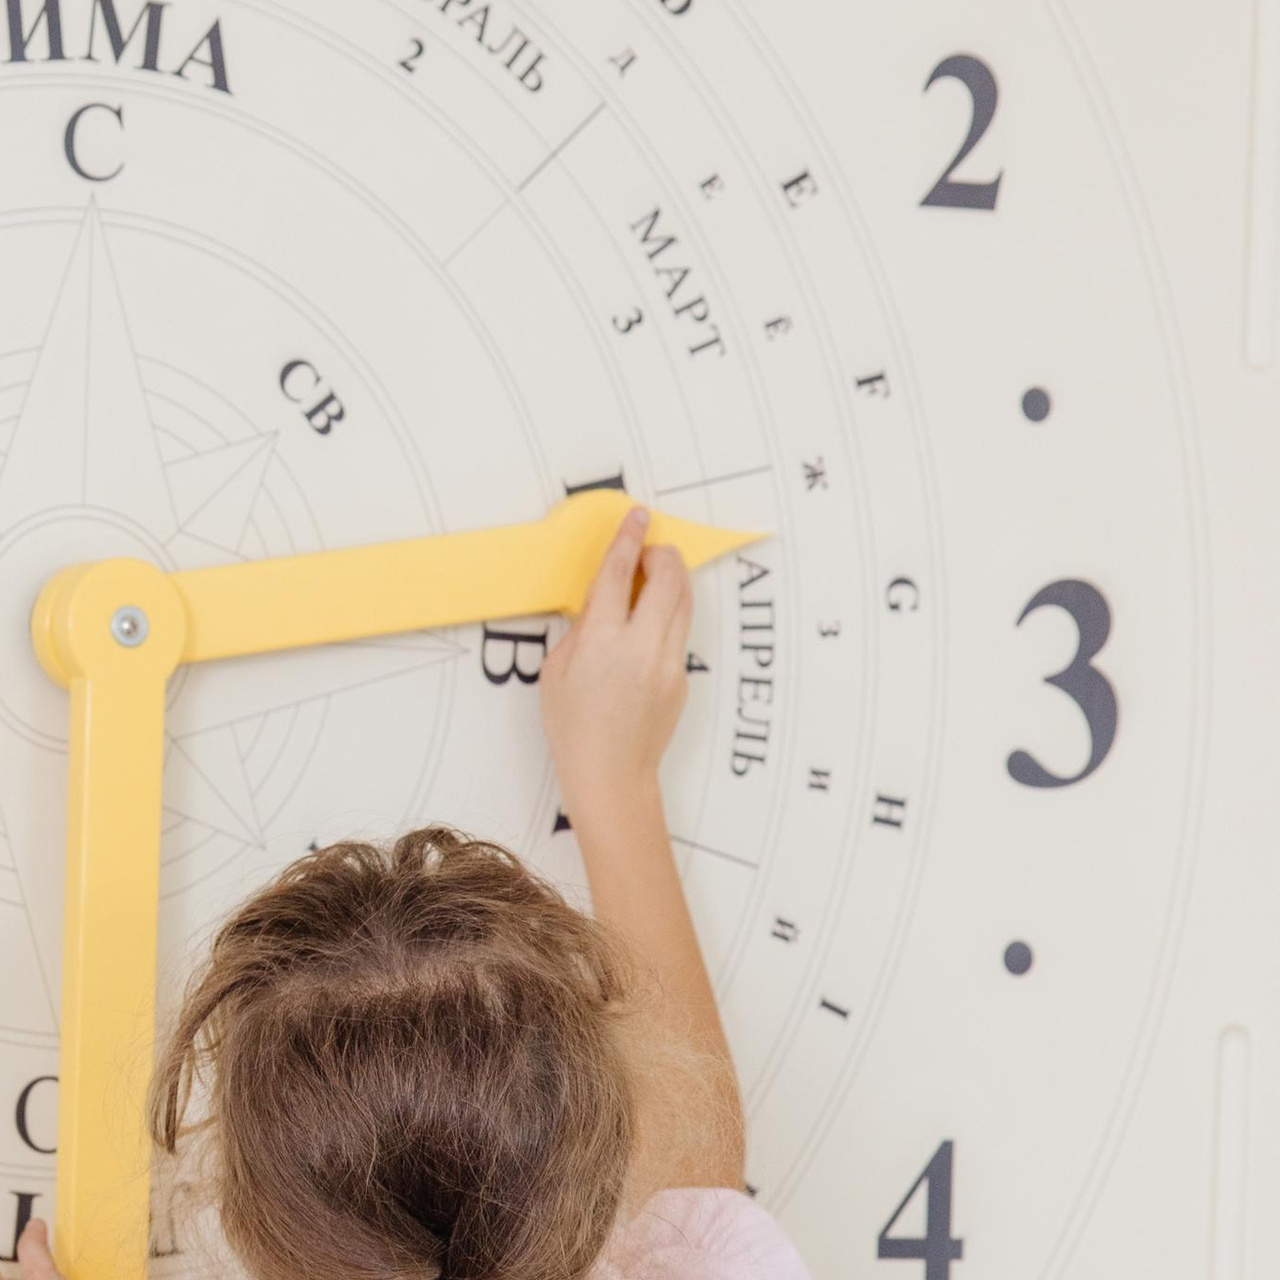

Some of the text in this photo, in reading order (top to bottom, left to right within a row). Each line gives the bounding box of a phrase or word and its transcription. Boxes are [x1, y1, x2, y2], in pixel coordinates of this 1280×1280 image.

[398, 38, 424, 74] 2
[918, 51, 1004, 212] 2
[779, 167, 818, 209] E
[631, 205, 726, 357] МАРТ
[612, 308, 644, 334] 3
[278, 358, 346, 436] СВ
[854, 369, 891, 398] F
[885, 574, 920, 613] G
[731, 555, 775, 777] АПРЕЛЬ
[1005, 577, 1121, 790] 3
[872, 793, 907, 830] H
